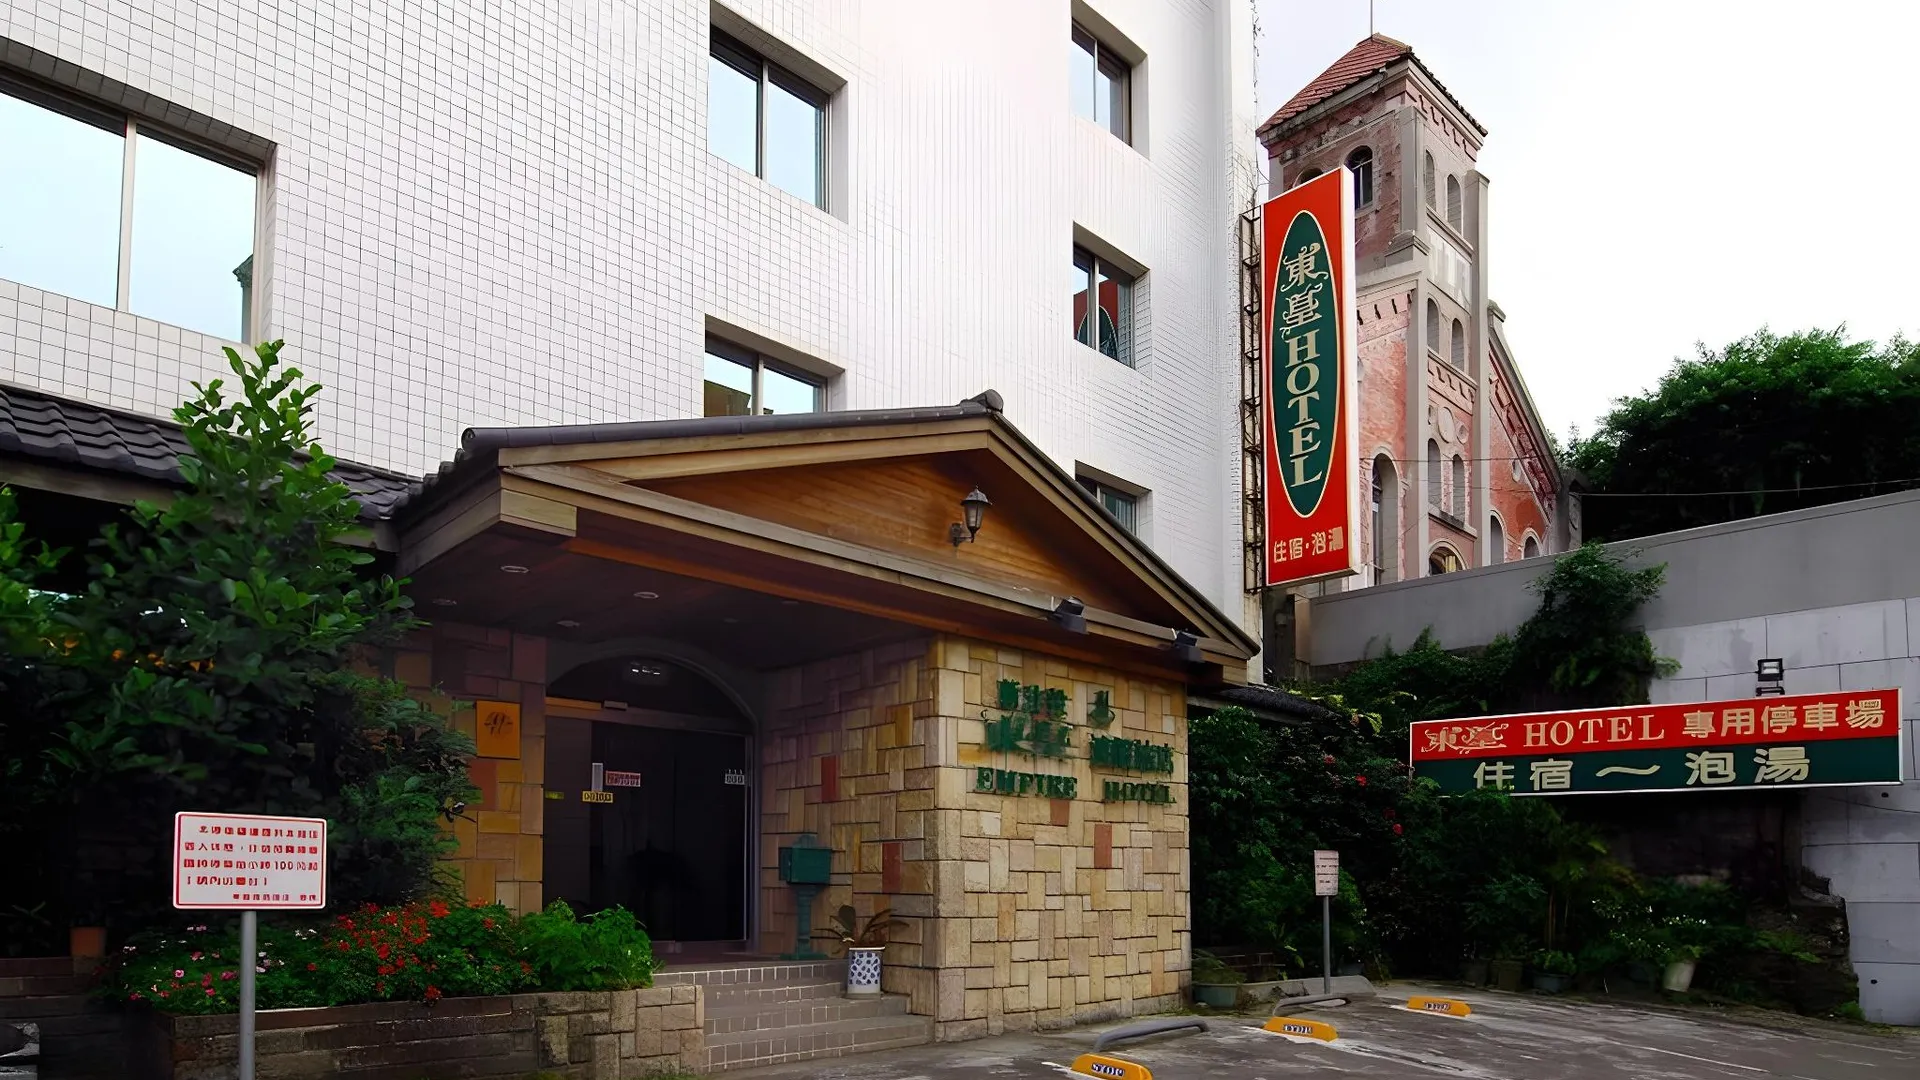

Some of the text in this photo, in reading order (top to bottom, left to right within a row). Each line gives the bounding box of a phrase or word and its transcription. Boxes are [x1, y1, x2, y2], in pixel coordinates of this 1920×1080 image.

[1284, 328, 1323, 488] HOTEL
[1523, 714, 1665, 748] HOTEL
[1682, 699, 1885, 738] 專用停車場
